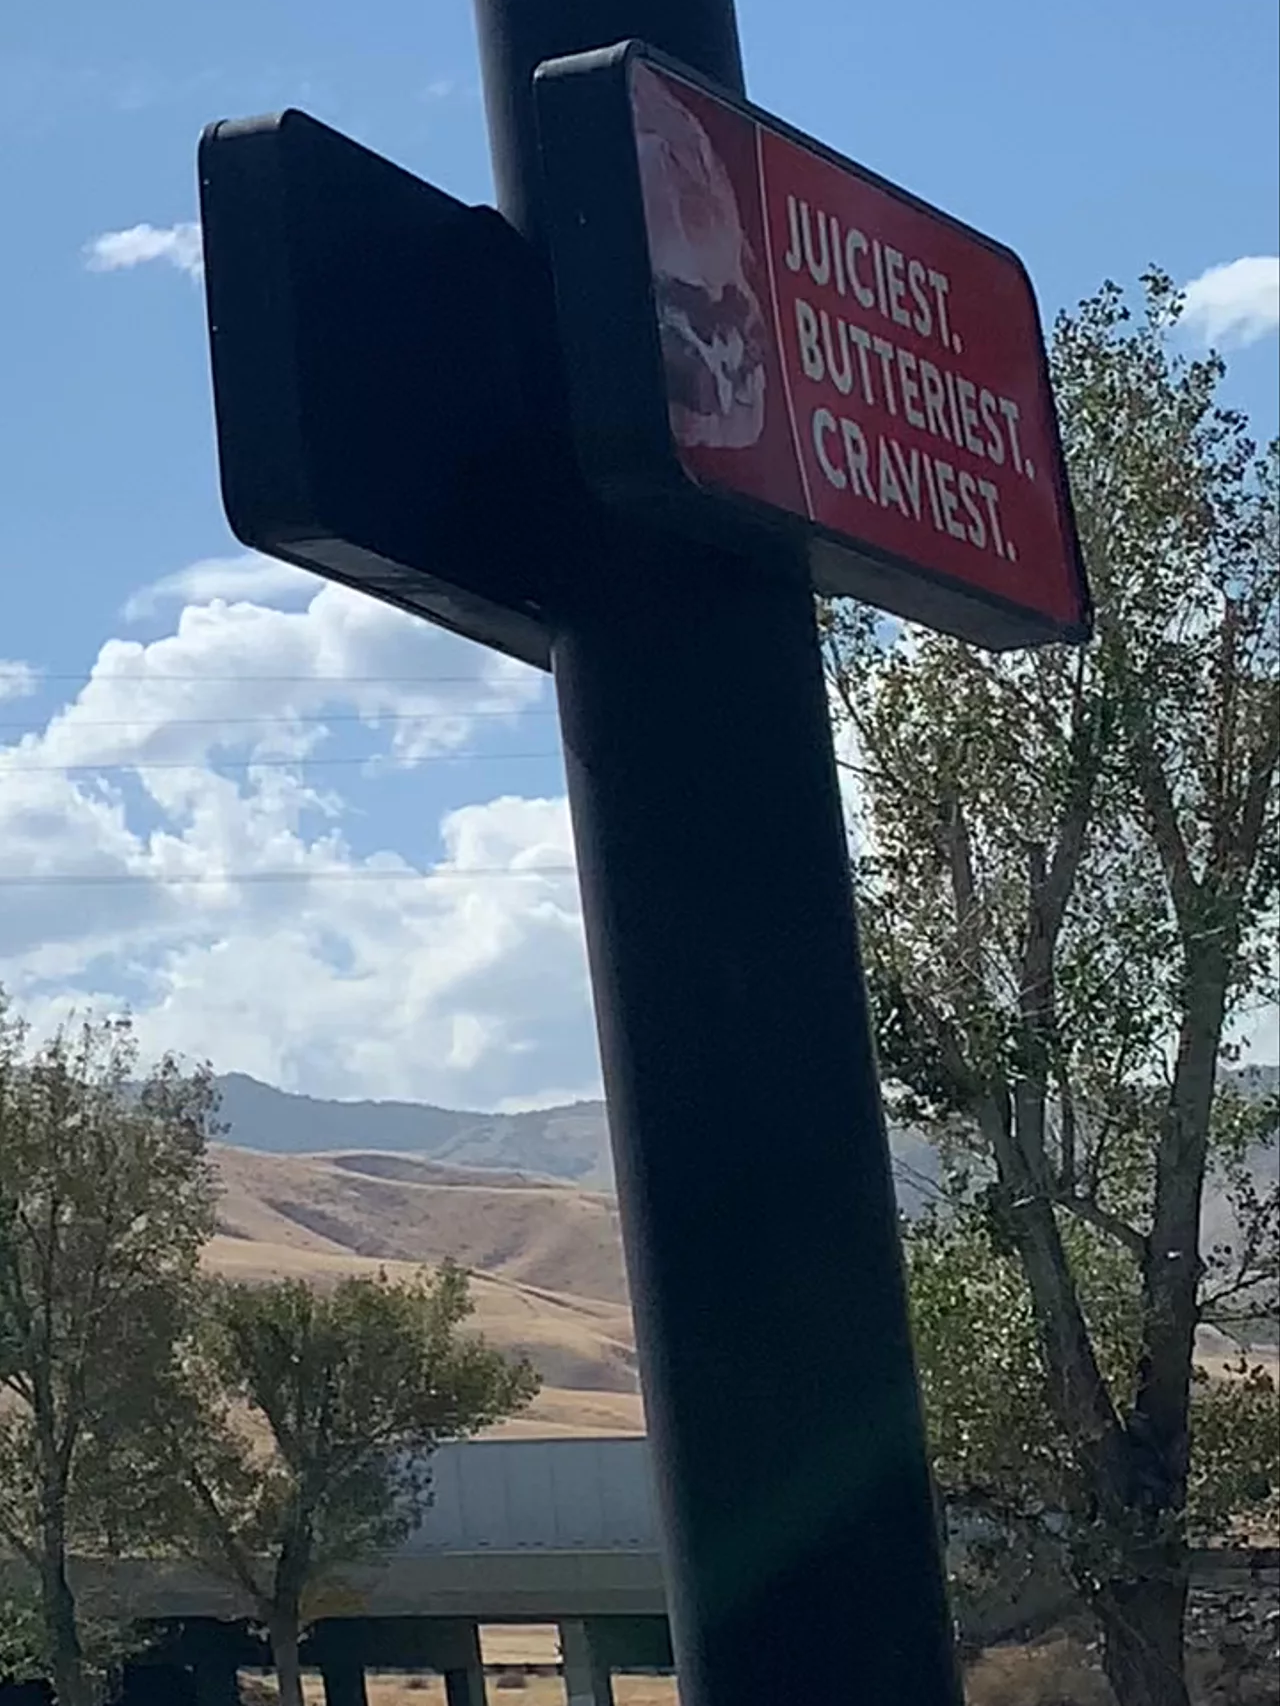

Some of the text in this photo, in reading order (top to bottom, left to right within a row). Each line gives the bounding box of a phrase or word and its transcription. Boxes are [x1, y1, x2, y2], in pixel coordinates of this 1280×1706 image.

[785, 194, 963, 355] JUICIEST.
[796, 298, 1035, 479] BUTTERIEST.
[812, 408, 1017, 562] CRAVIEST.
